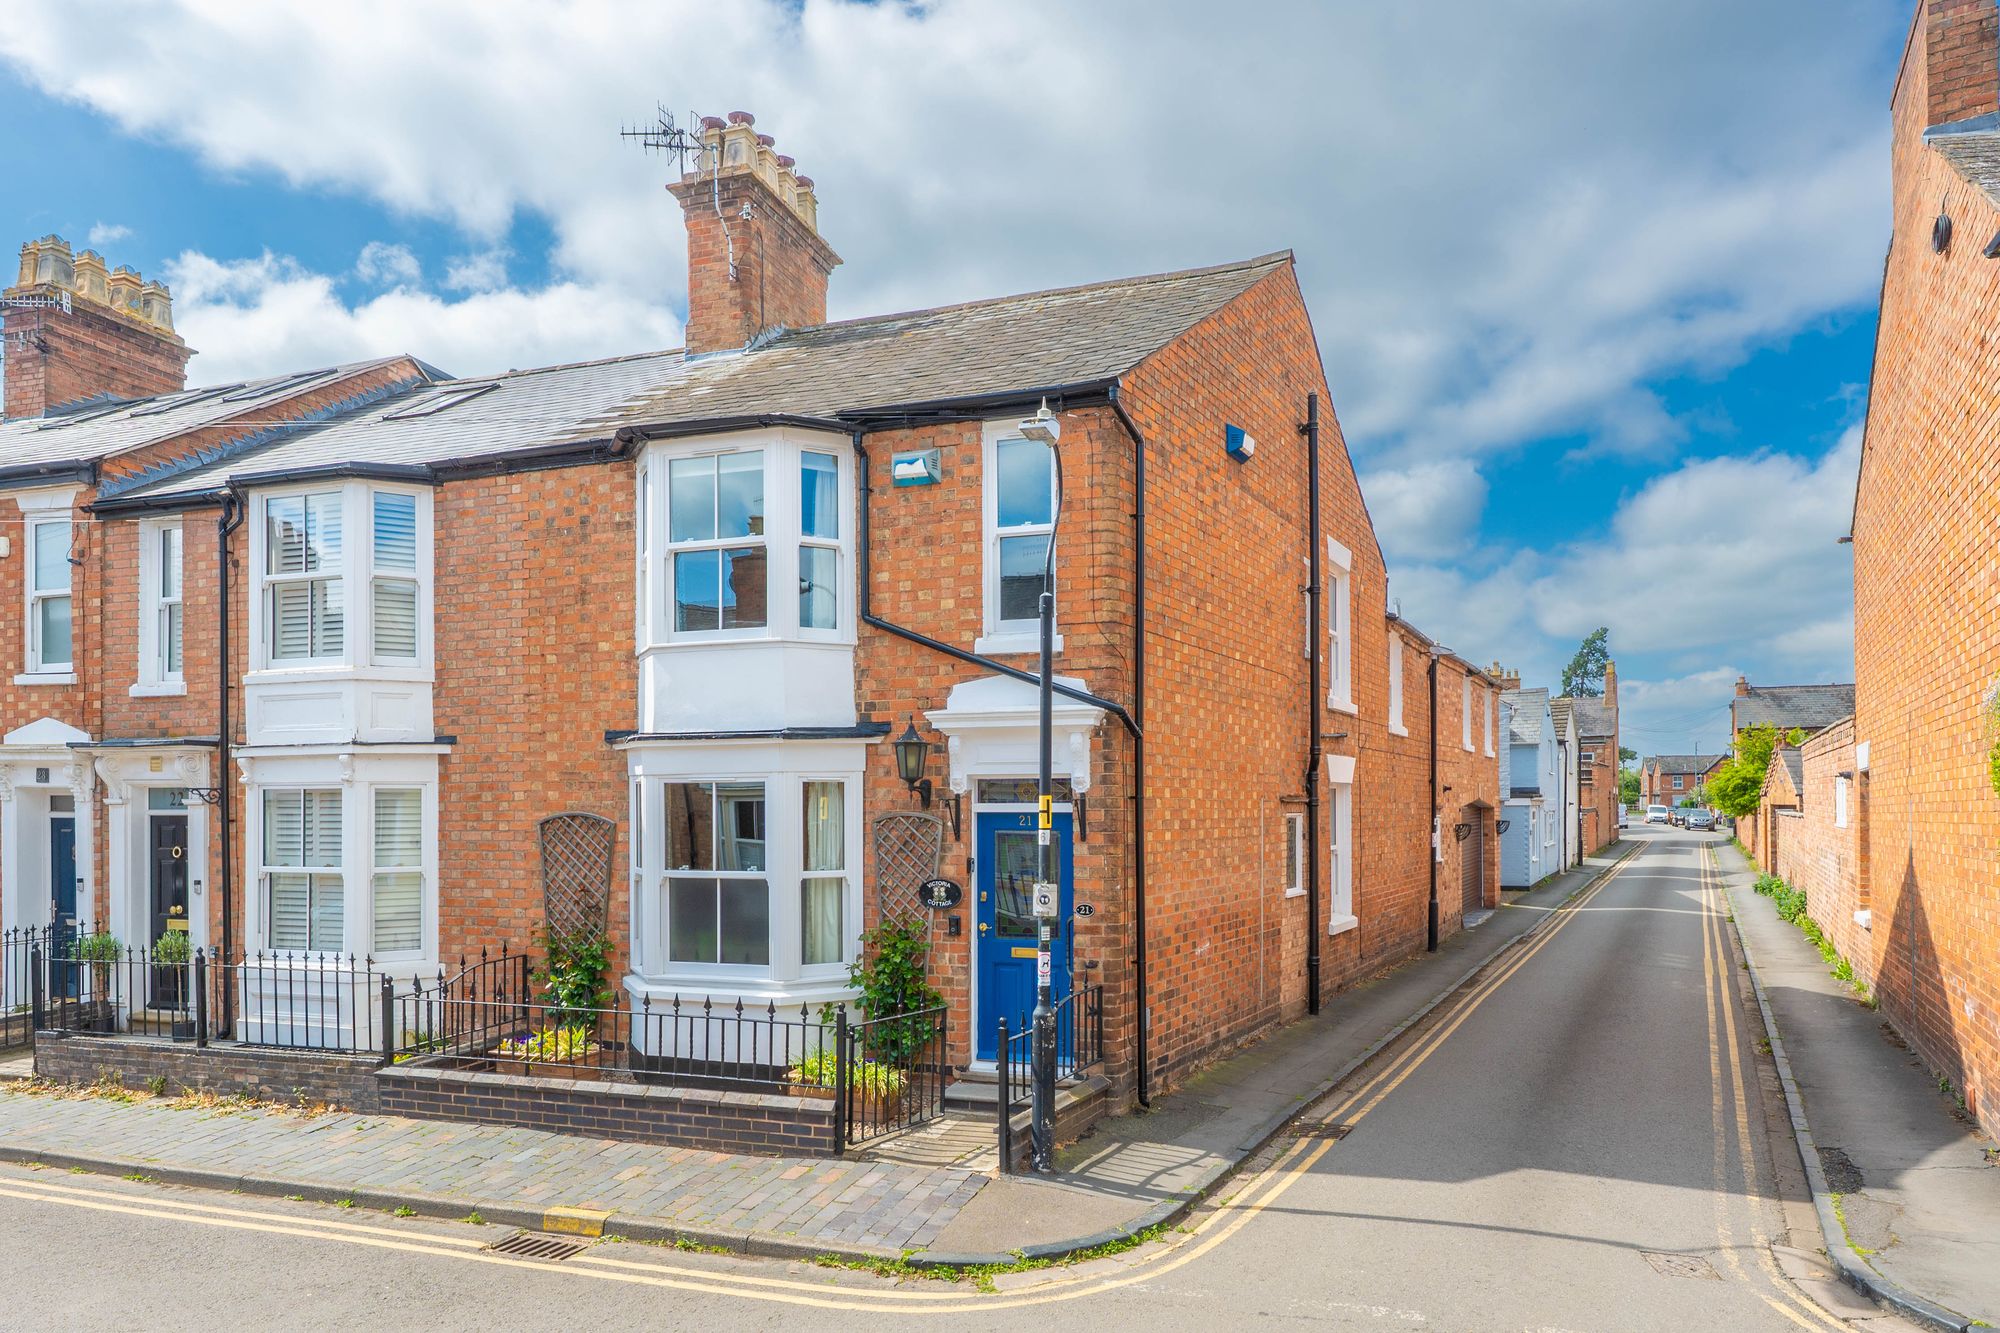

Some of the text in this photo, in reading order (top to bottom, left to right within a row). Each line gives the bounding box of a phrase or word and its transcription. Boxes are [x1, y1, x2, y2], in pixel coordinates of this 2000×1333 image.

[170, 792, 184, 806] 22
[1019, 815, 1032, 826] 21
[926, 880, 951, 888] VICTORIA
[927, 898, 953, 907] COTTAGE
[1079, 905, 1090, 914] 21
